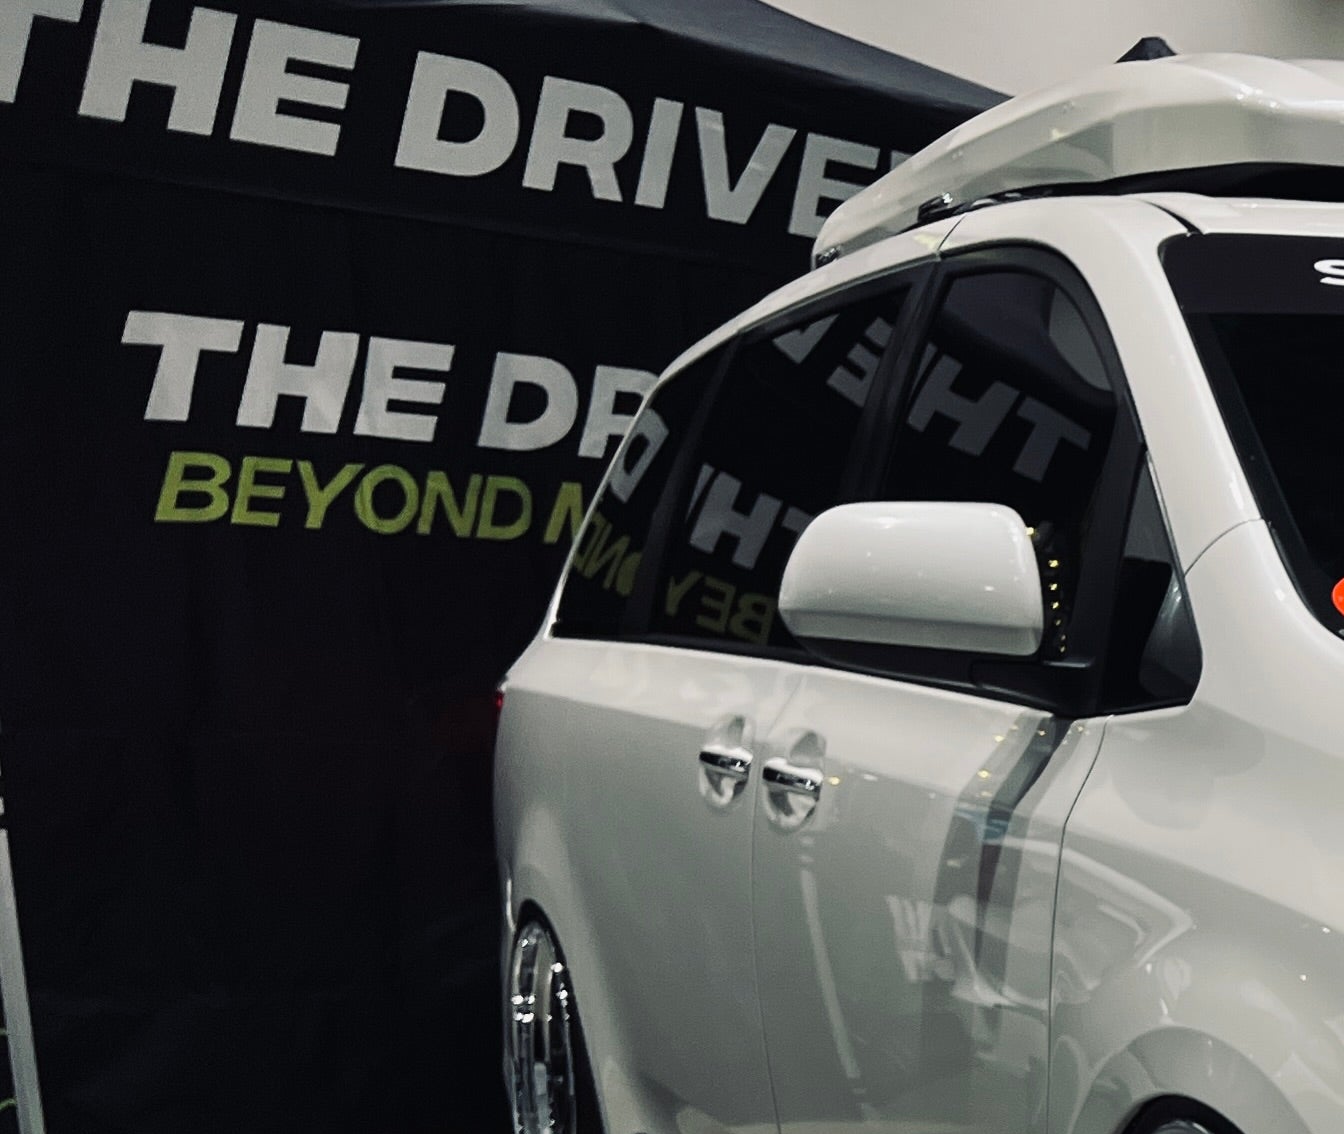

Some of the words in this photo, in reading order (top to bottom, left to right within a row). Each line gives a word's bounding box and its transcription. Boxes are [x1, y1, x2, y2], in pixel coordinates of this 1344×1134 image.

[394, 51, 918, 239] DRIVE
[121, 310, 456, 443] THE
[154, 450, 533, 542] BEYOND
